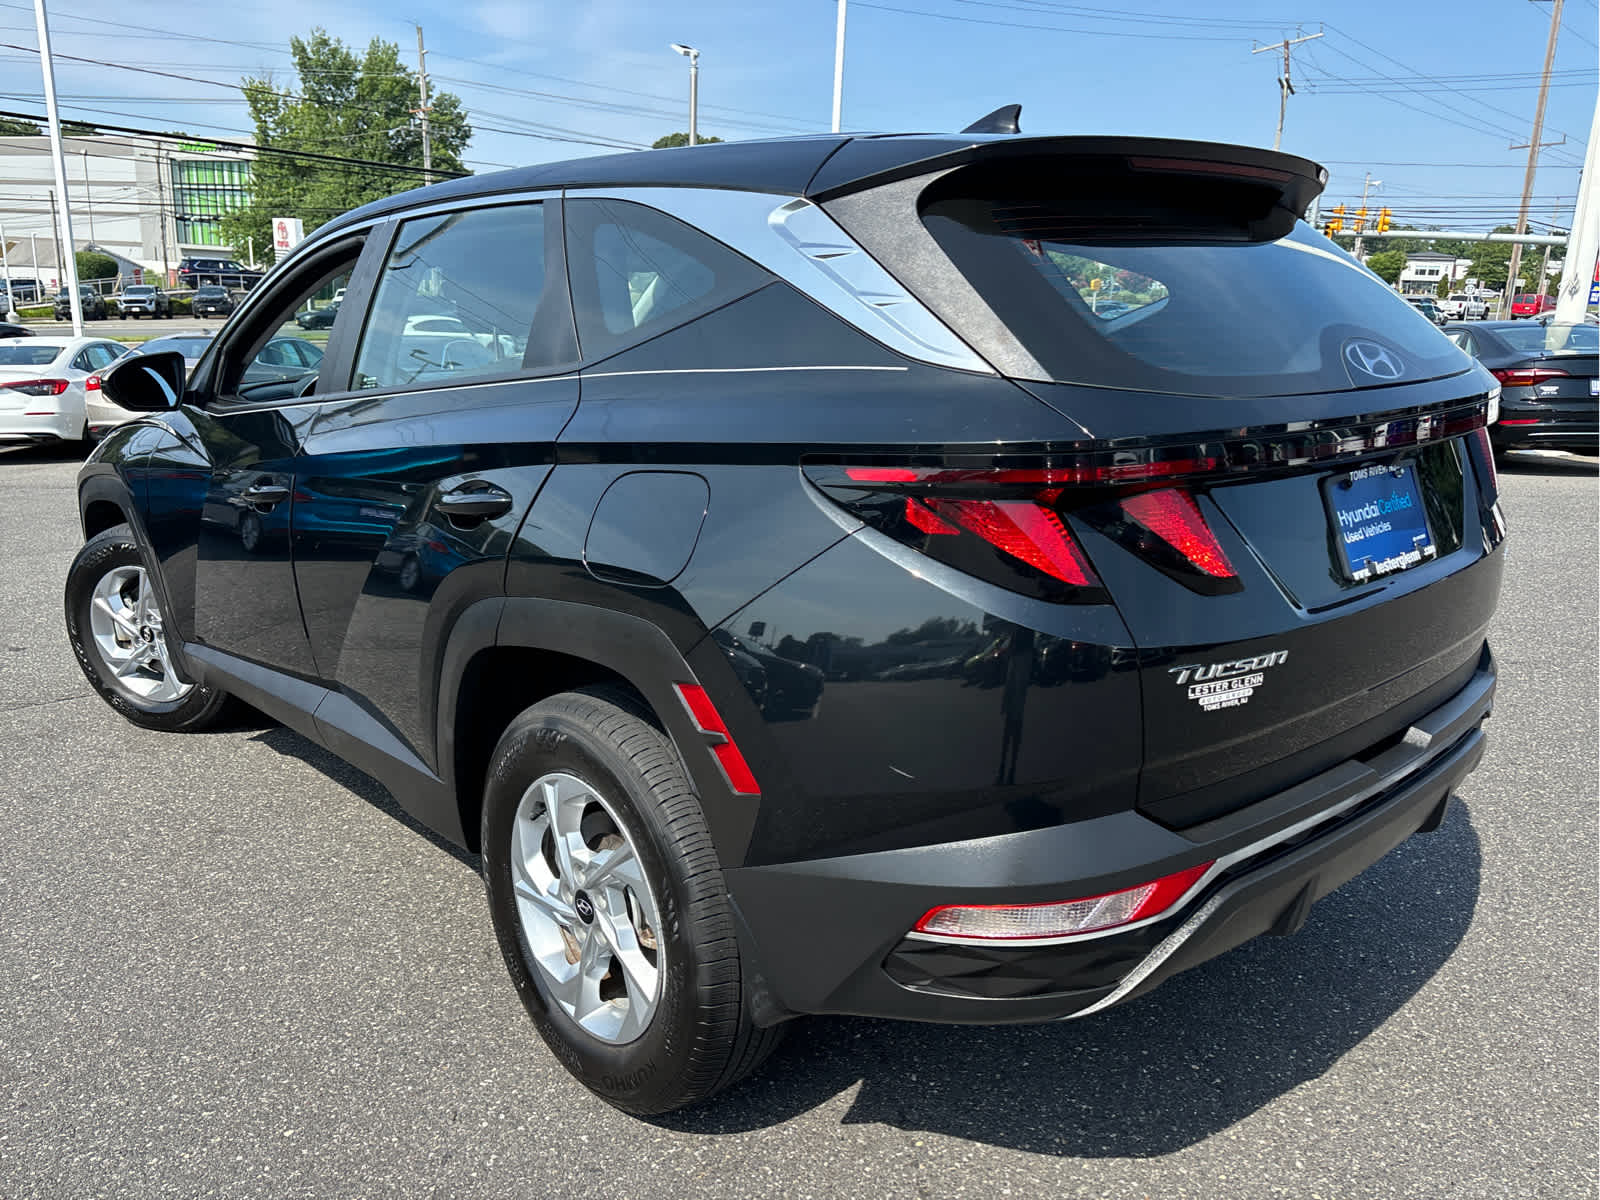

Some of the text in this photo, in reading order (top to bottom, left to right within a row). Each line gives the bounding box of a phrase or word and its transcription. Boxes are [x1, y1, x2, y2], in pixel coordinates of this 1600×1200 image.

[1349, 468, 1368, 481] TOMS
[1344, 520, 1392, 544] Used Vehicles
[1188, 674, 1264, 697] LESTER GLENN
[1203, 702, 1220, 711] TOMS
